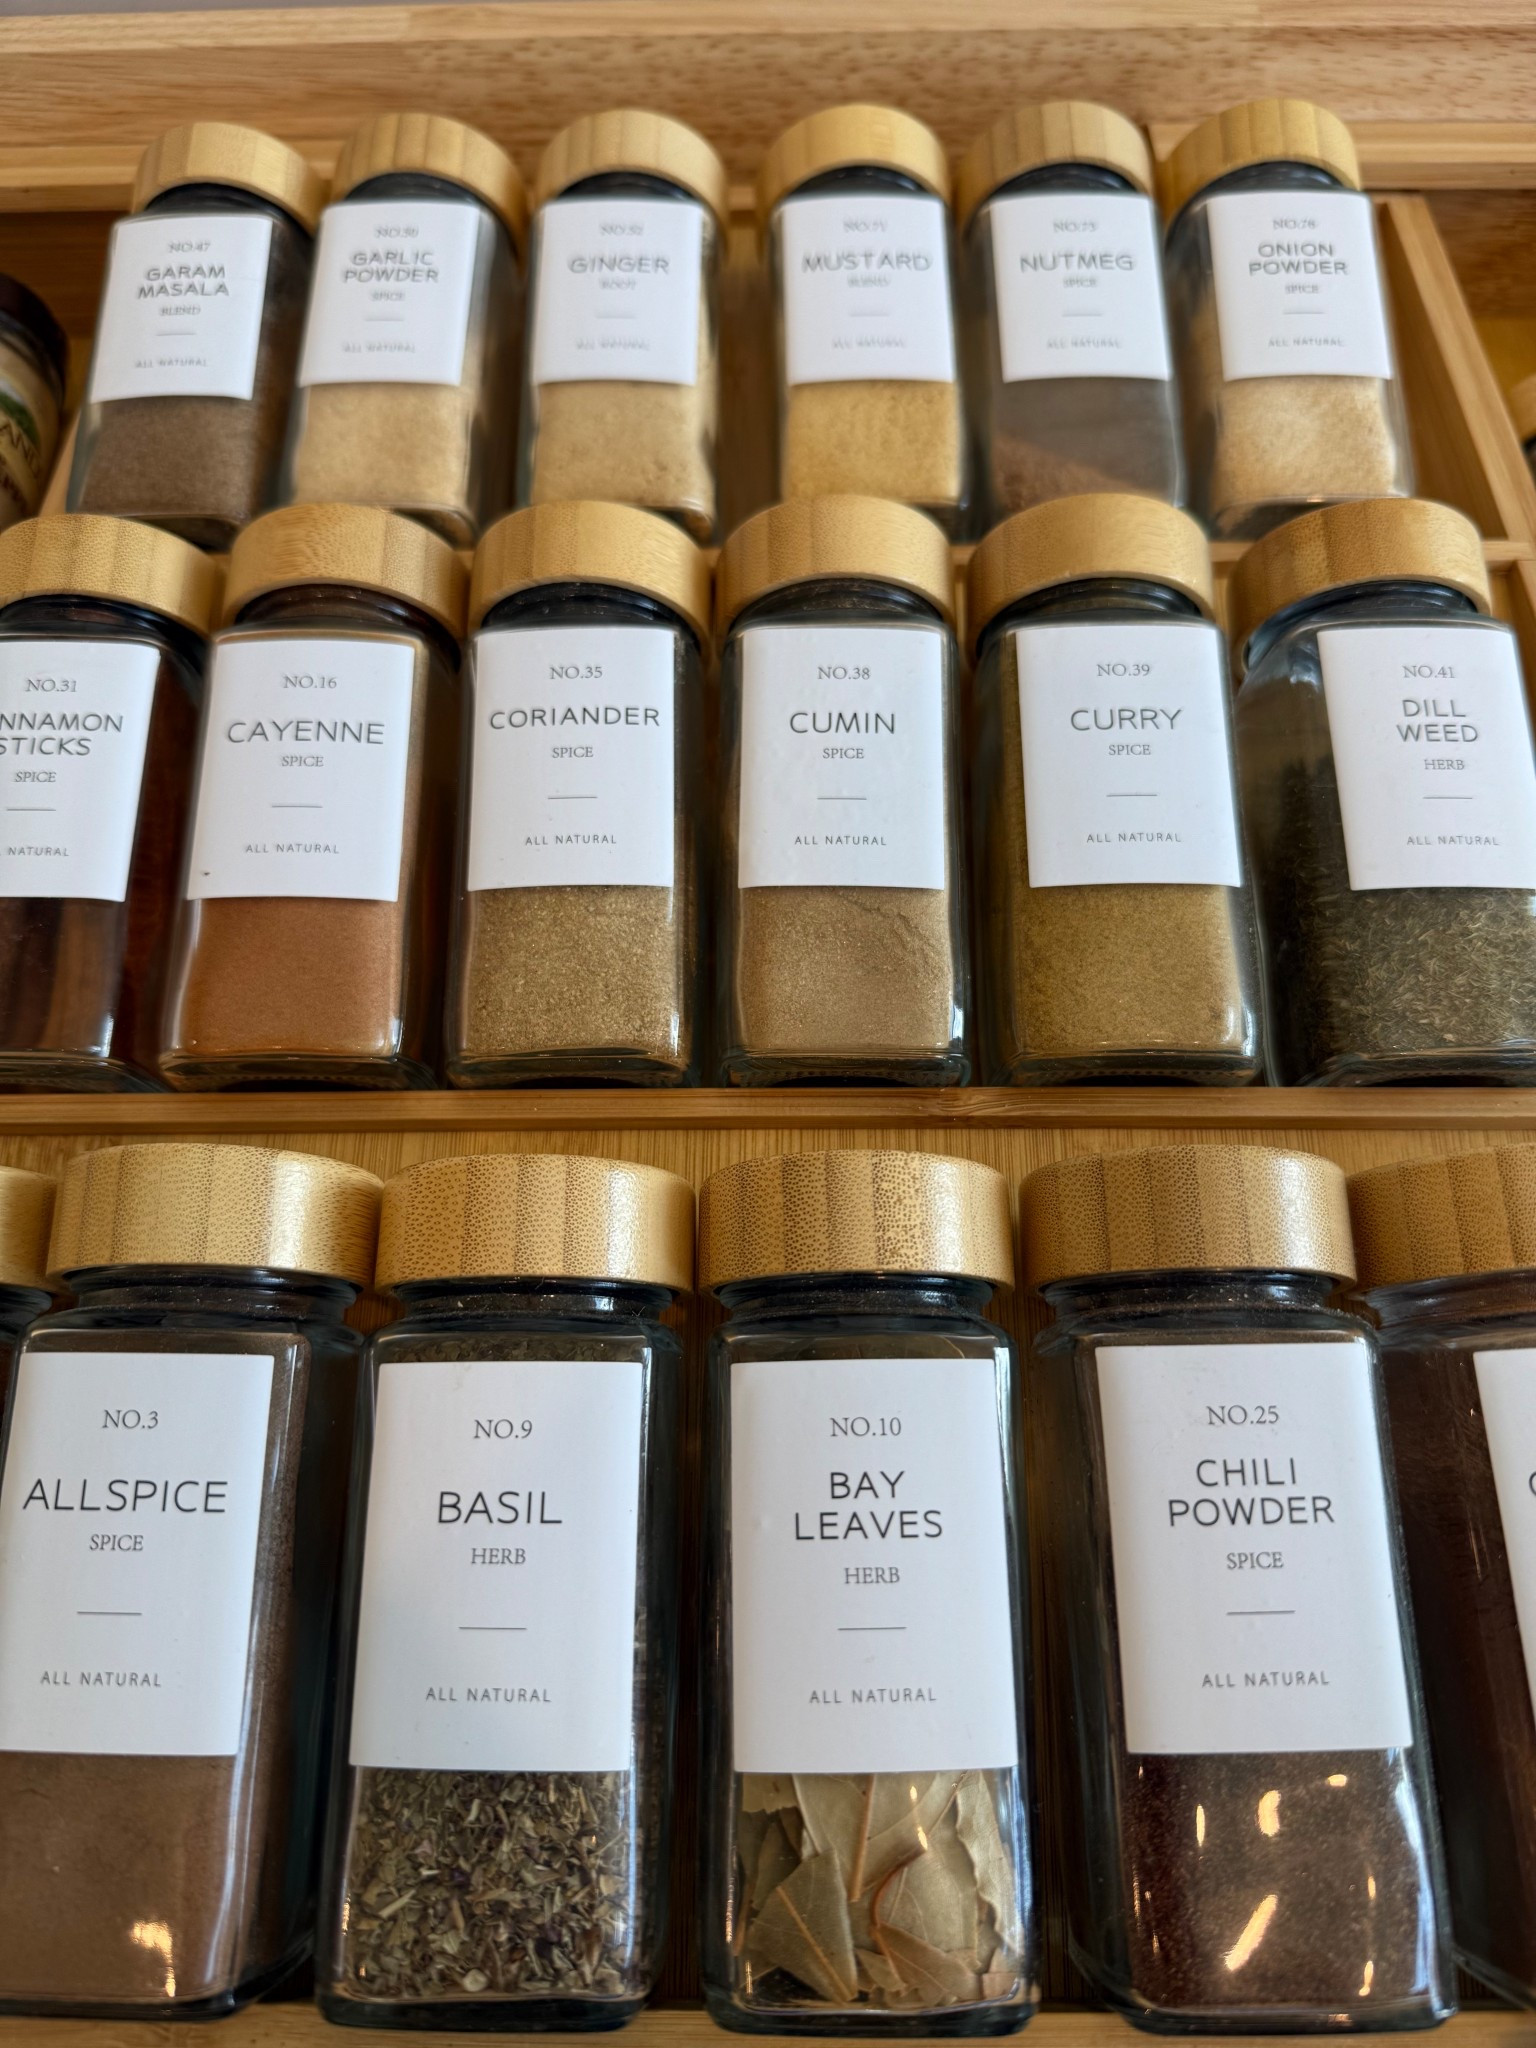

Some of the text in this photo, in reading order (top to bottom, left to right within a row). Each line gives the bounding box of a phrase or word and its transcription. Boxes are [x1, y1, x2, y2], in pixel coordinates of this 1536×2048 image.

[1257, 241, 1334, 257] ONION
[351, 249, 435, 267] GARLIC
[567, 255, 670, 274] GINGER
[801, 252, 930, 273] MUSTARD
[1019, 253, 1133, 273] NUTMEG
[1248, 257, 1348, 276] POWDER
[145, 264, 226, 282] GARAM
[343, 266, 440, 285] POWDER
[137, 280, 229, 299] MASALA
[1284, 284, 1319, 294] SPICE
[1292, 337, 1343, 347] NATURAL
[156, 358, 207, 367] NATURAL
[550, 666, 602, 679] NO.35
[818, 667, 870, 679] NO.38
[1097, 664, 1150, 676] NO.39
[1403, 666, 1455, 678] NO.41
[25, 679, 76, 692] NO.31
[283, 676, 336, 688] NO.16
[1402, 699, 1466, 717] DILL
[0, 713, 122, 731] NNAMON
[489, 707, 659, 729] CORIANDER
[790, 713, 894, 733] CUMIN
[1071, 709, 1181, 731] CURRY
[227, 721, 384, 744] CAYENNE
[1397, 724, 1478, 742] WEED
[0, 737, 91, 755] STICKS
[552, 747, 593, 758] SPICE
[823, 748, 864, 758] SPICE
[1109, 745, 1150, 755] SPICE
[282, 756, 323, 766] SPICE
[1424, 759, 1465, 770] HERB
[14, 772, 56, 782] SPICE
[525, 835, 616, 845] ALL NATURAL
[795, 836, 886, 845] ALL NATURAL
[1087, 833, 1180, 842] ALL NATURAL
[1407, 836, 1499, 845] ALL NATURAL
[7, 847, 68, 856] NATURAL
[246, 844, 338, 853] ALL NATURAL
[103, 1410, 158, 1429] NO.3
[1207, 1405, 1279, 1425] NO.25
[474, 1420, 532, 1438] NO.9
[830, 1417, 901, 1437] NO.10
[1196, 1459, 1296, 1487] CHILI
[831, 1471, 904, 1499] BAY
[23, 1479, 227, 1512] ALLSPICE
[438, 1491, 562, 1524] BASIL
[1169, 1496, 1334, 1526] POWDER
[795, 1510, 942, 1540] LEAVES
[90, 1534, 143, 1551] SPICE
[471, 1548, 525, 1564] HERB
[1227, 1552, 1283, 1570] SPICE
[845, 1567, 900, 1584] HERB
[41, 1671, 160, 1686] ALL NATURAL
[1202, 1671, 1328, 1688] ALL NATURAL
[426, 1688, 550, 1702] ALL NATURAL
[810, 1688, 936, 1703] ALL NATURAL
